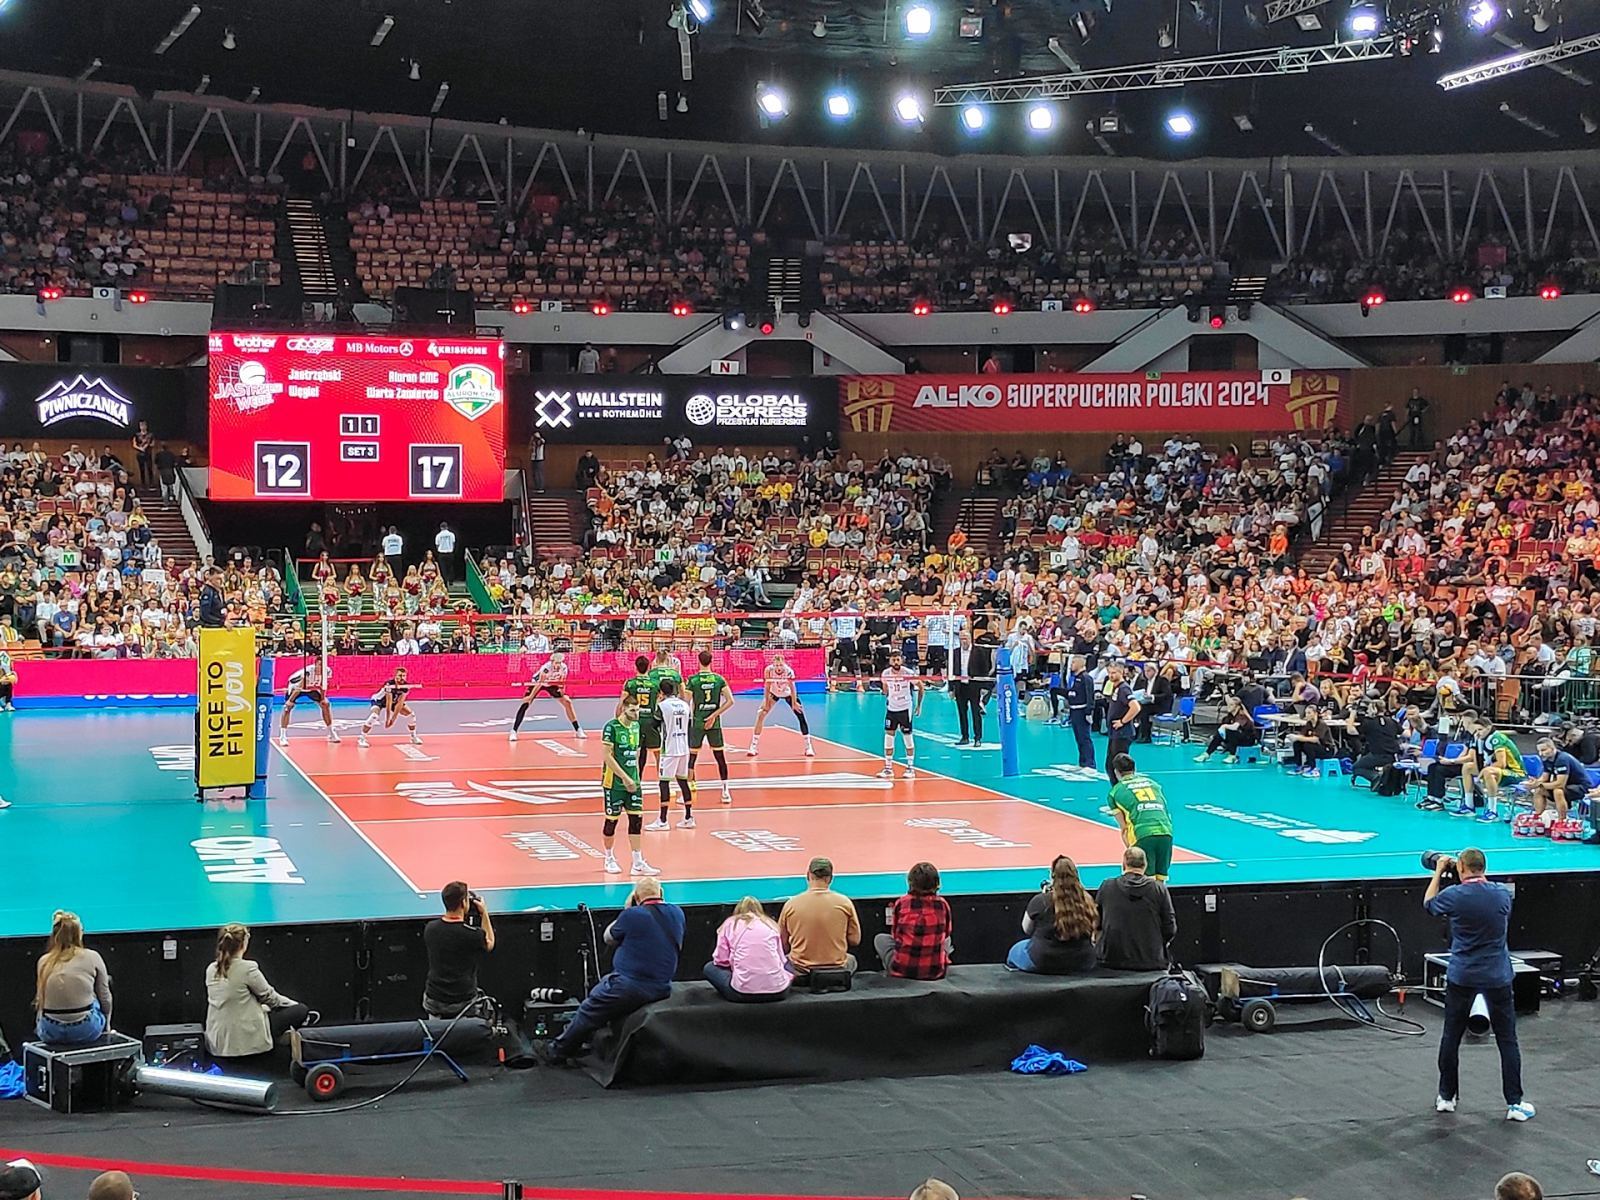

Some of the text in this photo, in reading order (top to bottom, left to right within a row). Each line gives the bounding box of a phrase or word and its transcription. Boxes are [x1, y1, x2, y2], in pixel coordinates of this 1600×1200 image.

[548, 302, 555, 311] P
[1048, 302, 1056, 311] R
[234, 336, 276, 348] brother
[346, 342, 363, 353] MB
[365, 343, 399, 354] Motors
[438, 346, 488, 355] KRISHOME
[719, 362, 731, 373] N
[1271, 371, 1282, 382] O
[576, 392, 663, 407] WALLSTEIN
[716, 394, 807, 407] GLOBAL
[912, 381, 1269, 408] AL-KO SUPERPUCHAR POLSKI 2024
[39, 393, 129, 425] PIWNICZANKA
[602, 409, 663, 419] ROTHEMÜHLE
[716, 406, 807, 418] EXPRESS
[347, 419, 372, 432] 1 1
[759, 418, 807, 426] KURIERSKIE
[347, 446, 374, 457] SET 3
[262, 454, 302, 488] 12
[417, 456, 454, 489] 17
[63, 554, 75, 564] M
[660, 550, 669, 561] N
[1366, 560, 1373, 571] P
[207, 662, 225, 757] NICE TO
[226, 661, 251, 756] FIT you
[256, 711, 265, 741] Senoh
[190, 836, 305, 885] AL-KO
